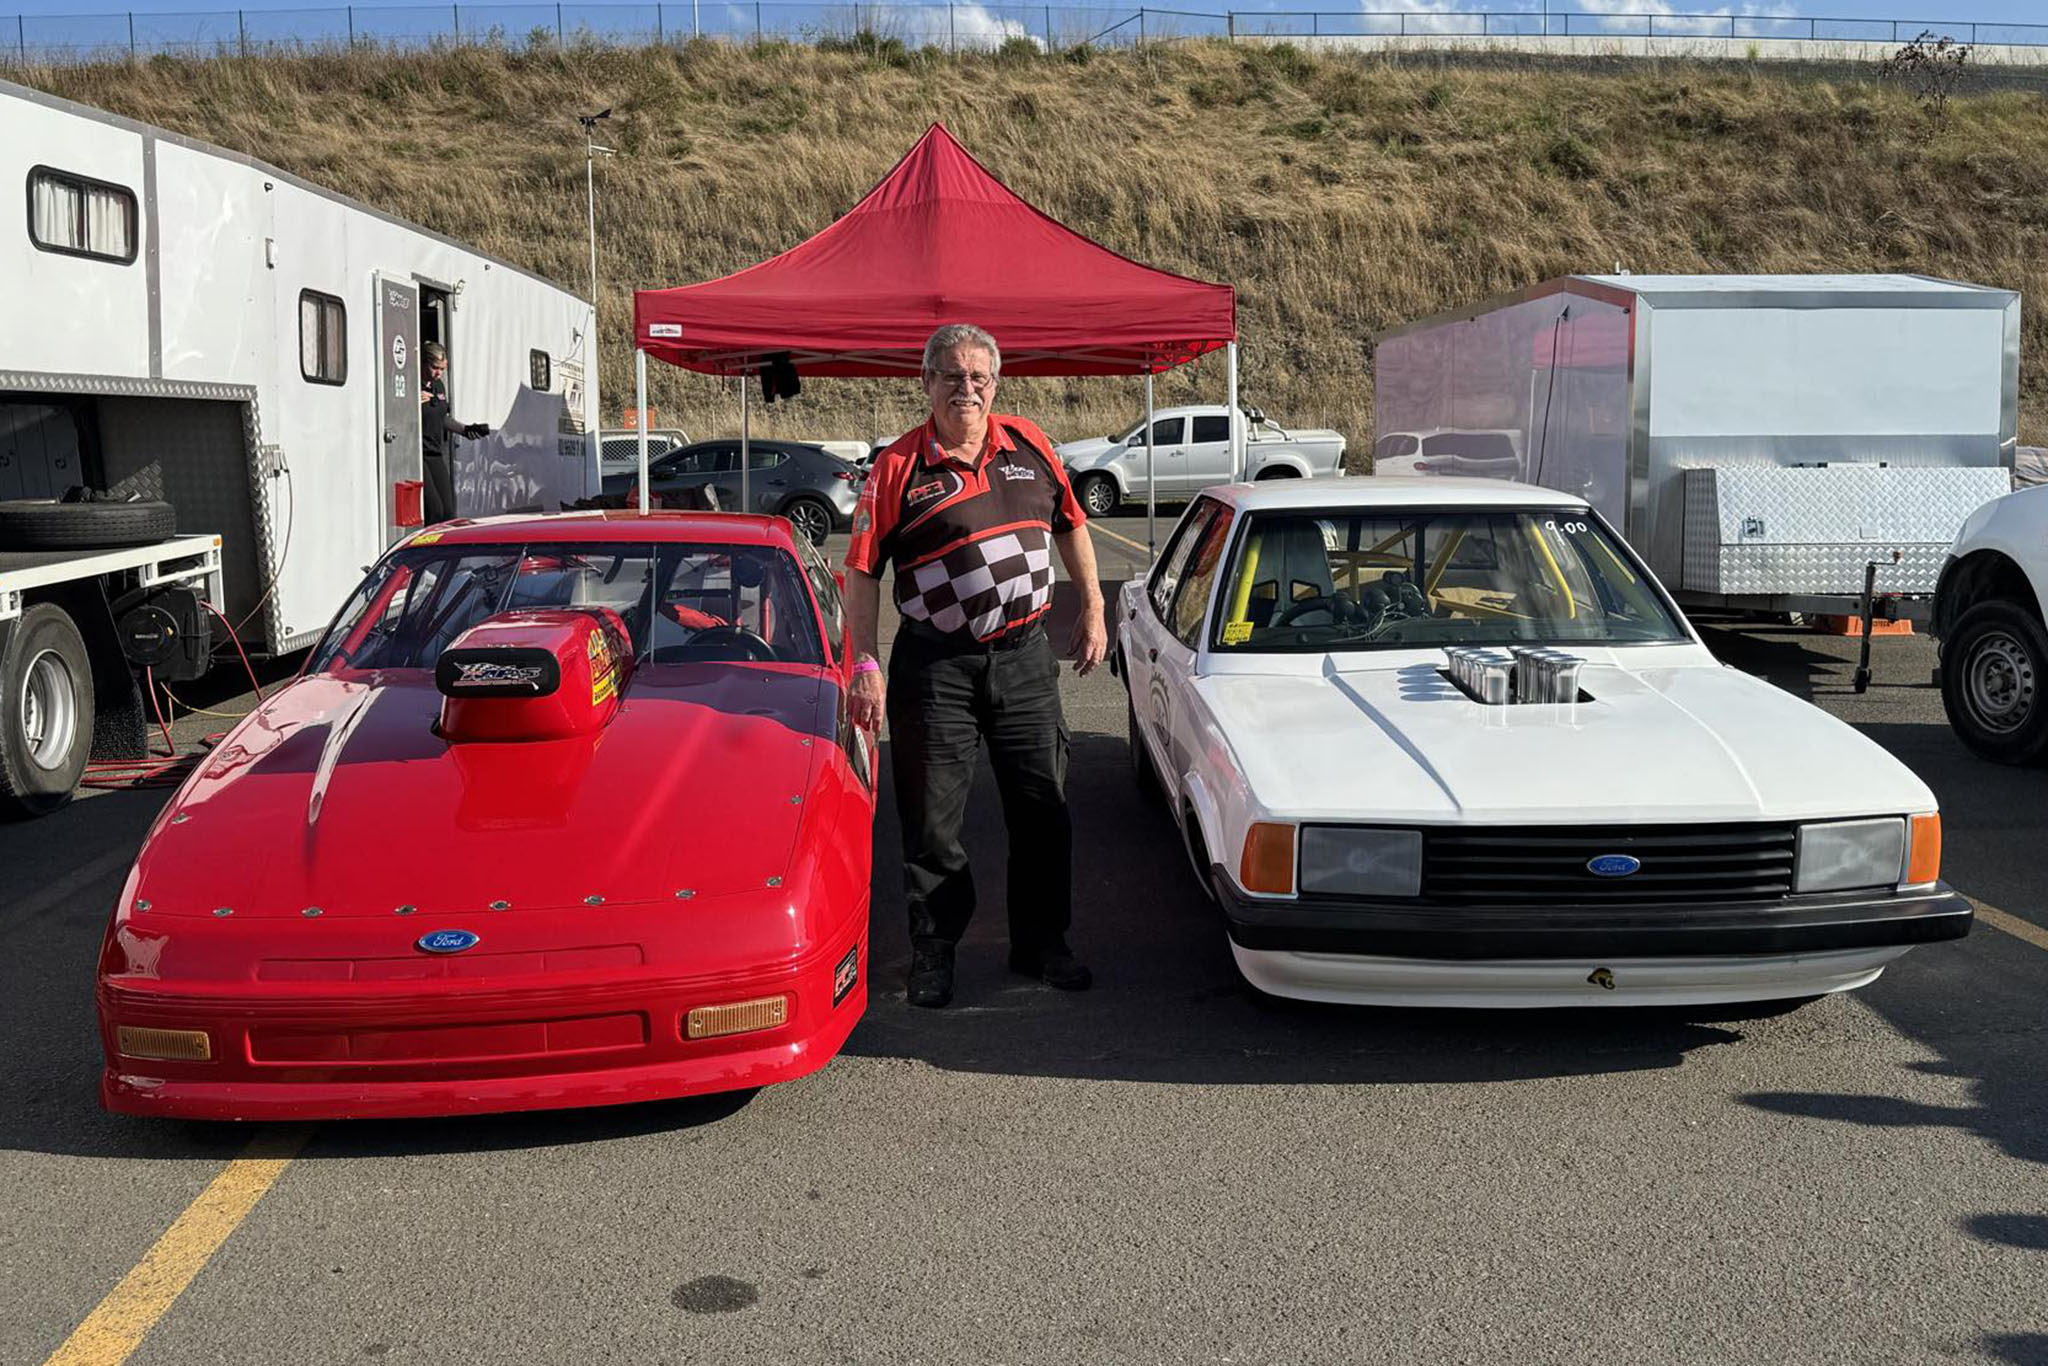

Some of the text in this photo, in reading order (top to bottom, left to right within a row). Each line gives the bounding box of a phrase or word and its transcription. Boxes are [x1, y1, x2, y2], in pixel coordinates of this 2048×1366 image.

[1544, 520, 1588, 543] 9.00
[1598, 858, 1630, 871] Ford
[432, 934, 465, 946] Ford
